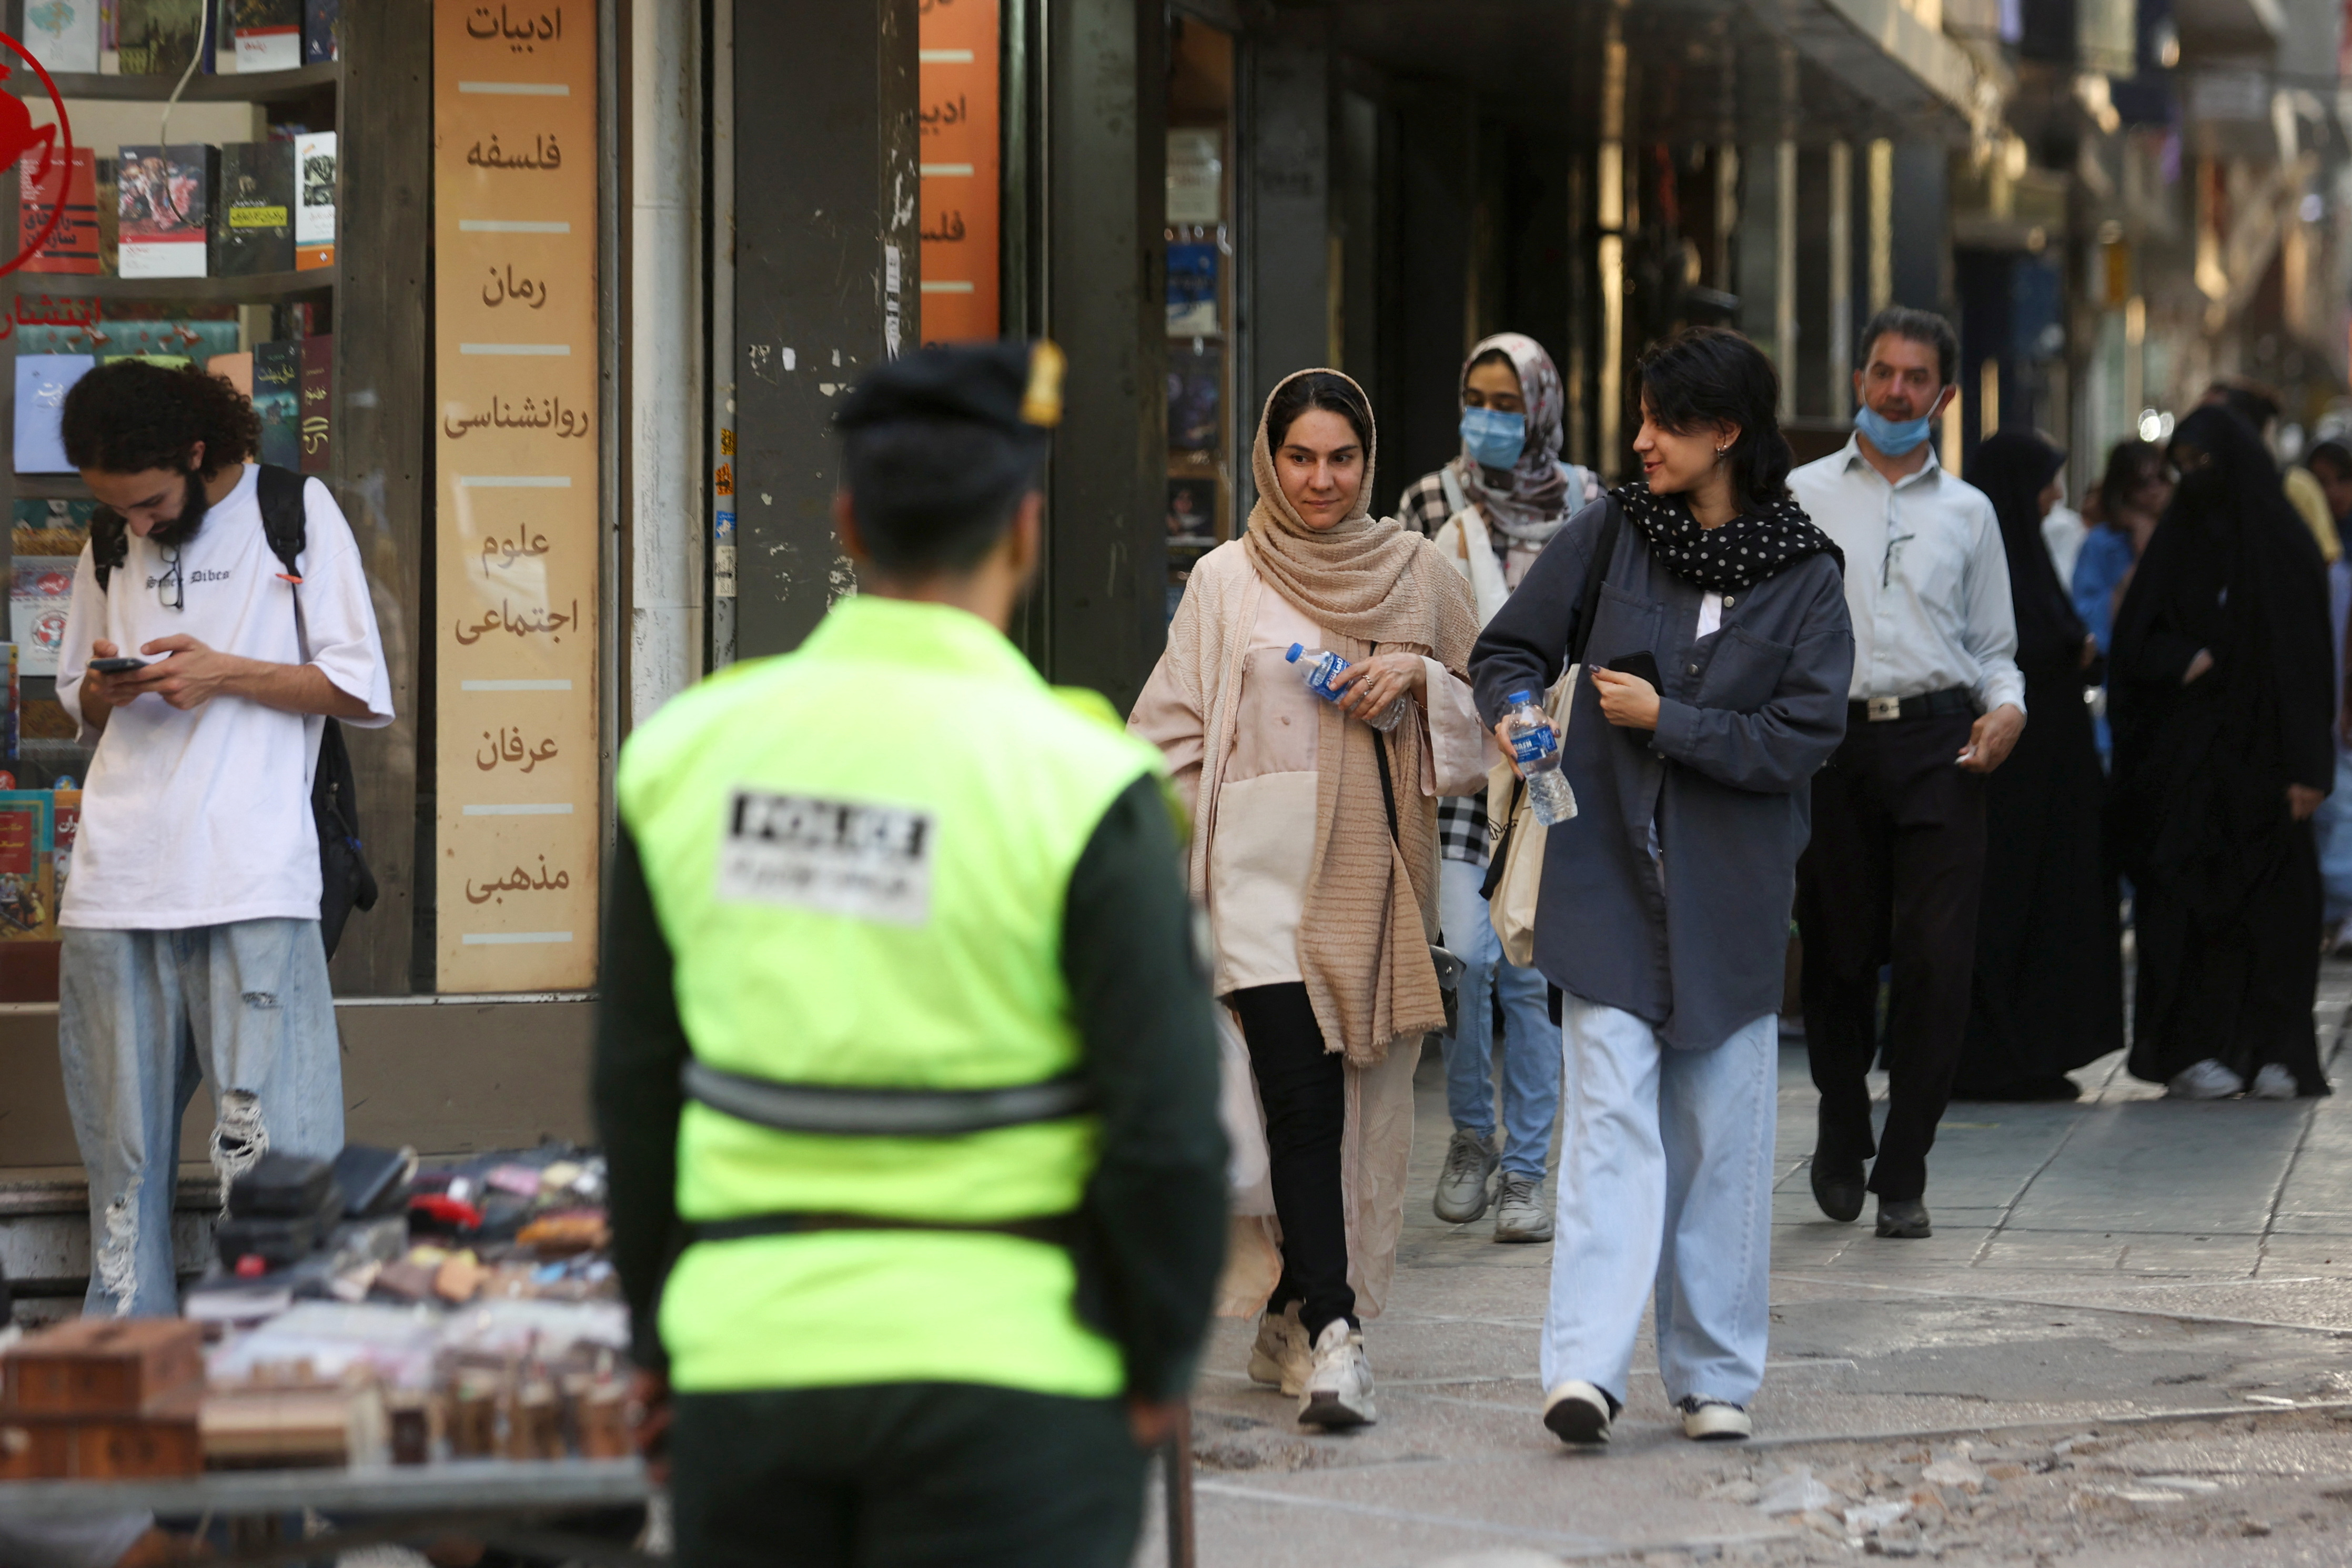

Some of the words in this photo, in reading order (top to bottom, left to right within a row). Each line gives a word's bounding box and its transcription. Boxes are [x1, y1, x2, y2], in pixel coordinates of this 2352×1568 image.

[467, 3, 561, 54] ادبیات
[466, 133, 562, 170] فلسفه
[482, 264, 547, 309] رمان
[444, 394, 589, 439] روانشناسی
[482, 522, 551, 579] علوم
[456, 598, 578, 645] اجتماعی
[476, 725, 559, 774] عرفان
[466, 854, 570, 905] مذهبی
